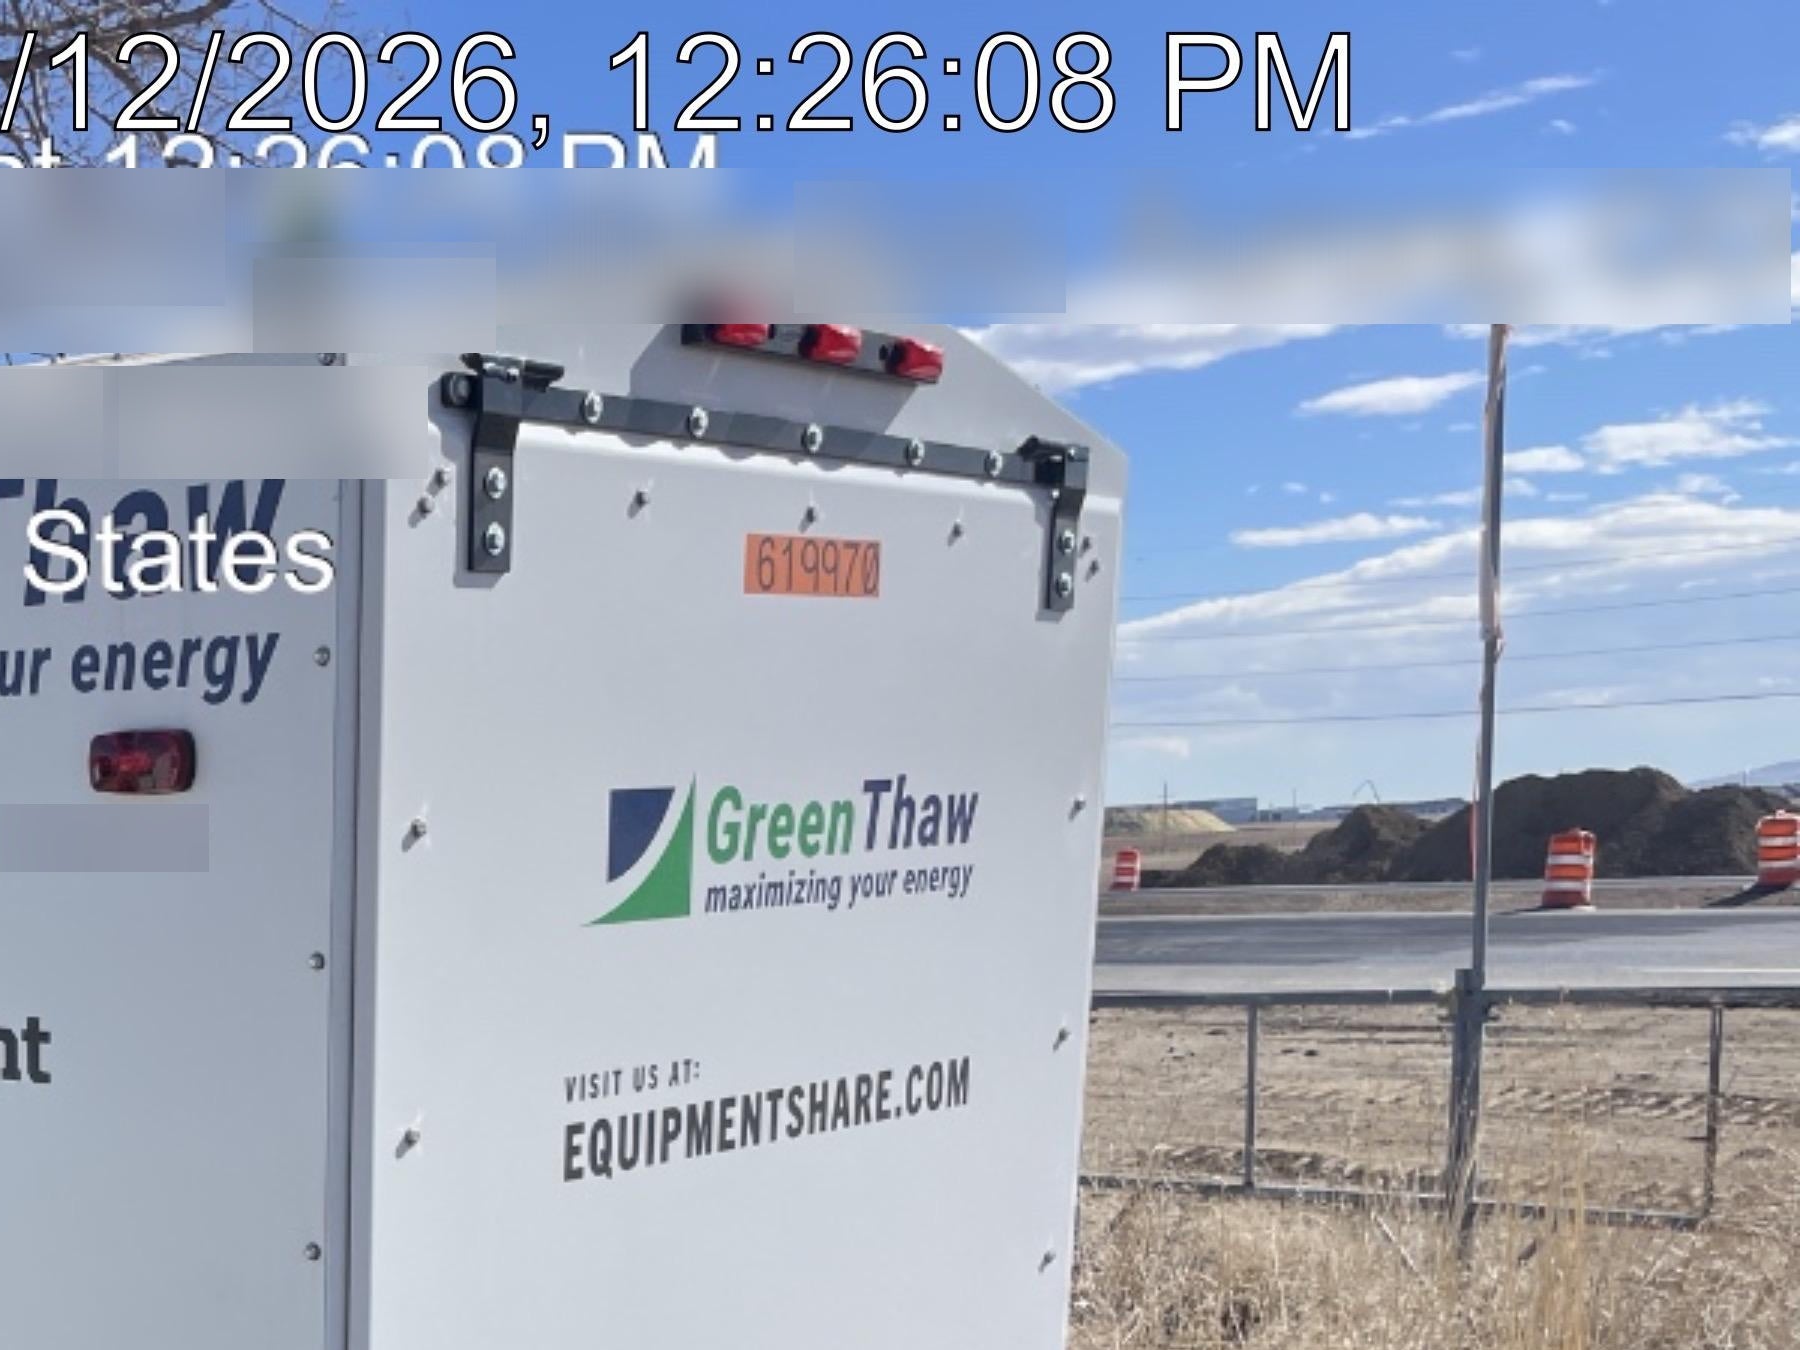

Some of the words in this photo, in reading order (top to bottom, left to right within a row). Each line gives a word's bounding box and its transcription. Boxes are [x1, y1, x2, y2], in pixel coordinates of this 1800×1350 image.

[757, 536, 880, 595] 619970
[69, 630, 281, 705] energy
[704, 868, 843, 913] maximizing
[847, 868, 898, 910] your
[902, 863, 975, 898] energy
[564, 1068, 623, 1103] VISIT
[632, 1063, 659, 1093] US
[668, 1057, 701, 1088] AT:
[563, 1056, 972, 1182] EQUIPMENTSHARE.COM
